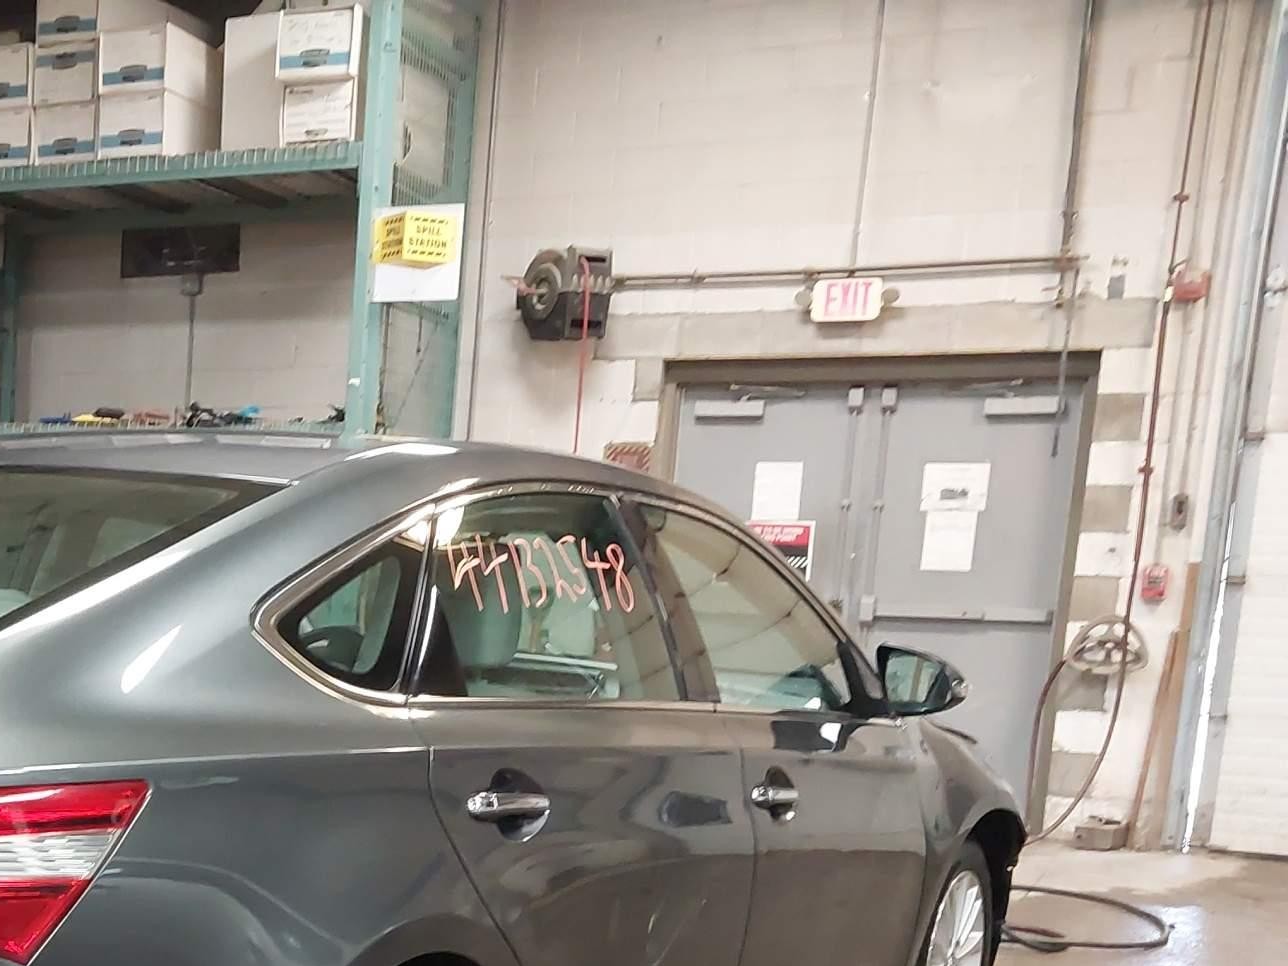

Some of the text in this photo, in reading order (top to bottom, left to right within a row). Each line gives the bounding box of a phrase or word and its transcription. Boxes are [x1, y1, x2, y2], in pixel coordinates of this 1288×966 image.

[416, 225, 442, 236] SPILL
[408, 237, 447, 249] STATION
[823, 281, 873, 317] EXIT
[446, 533, 635, 614] 44132548
